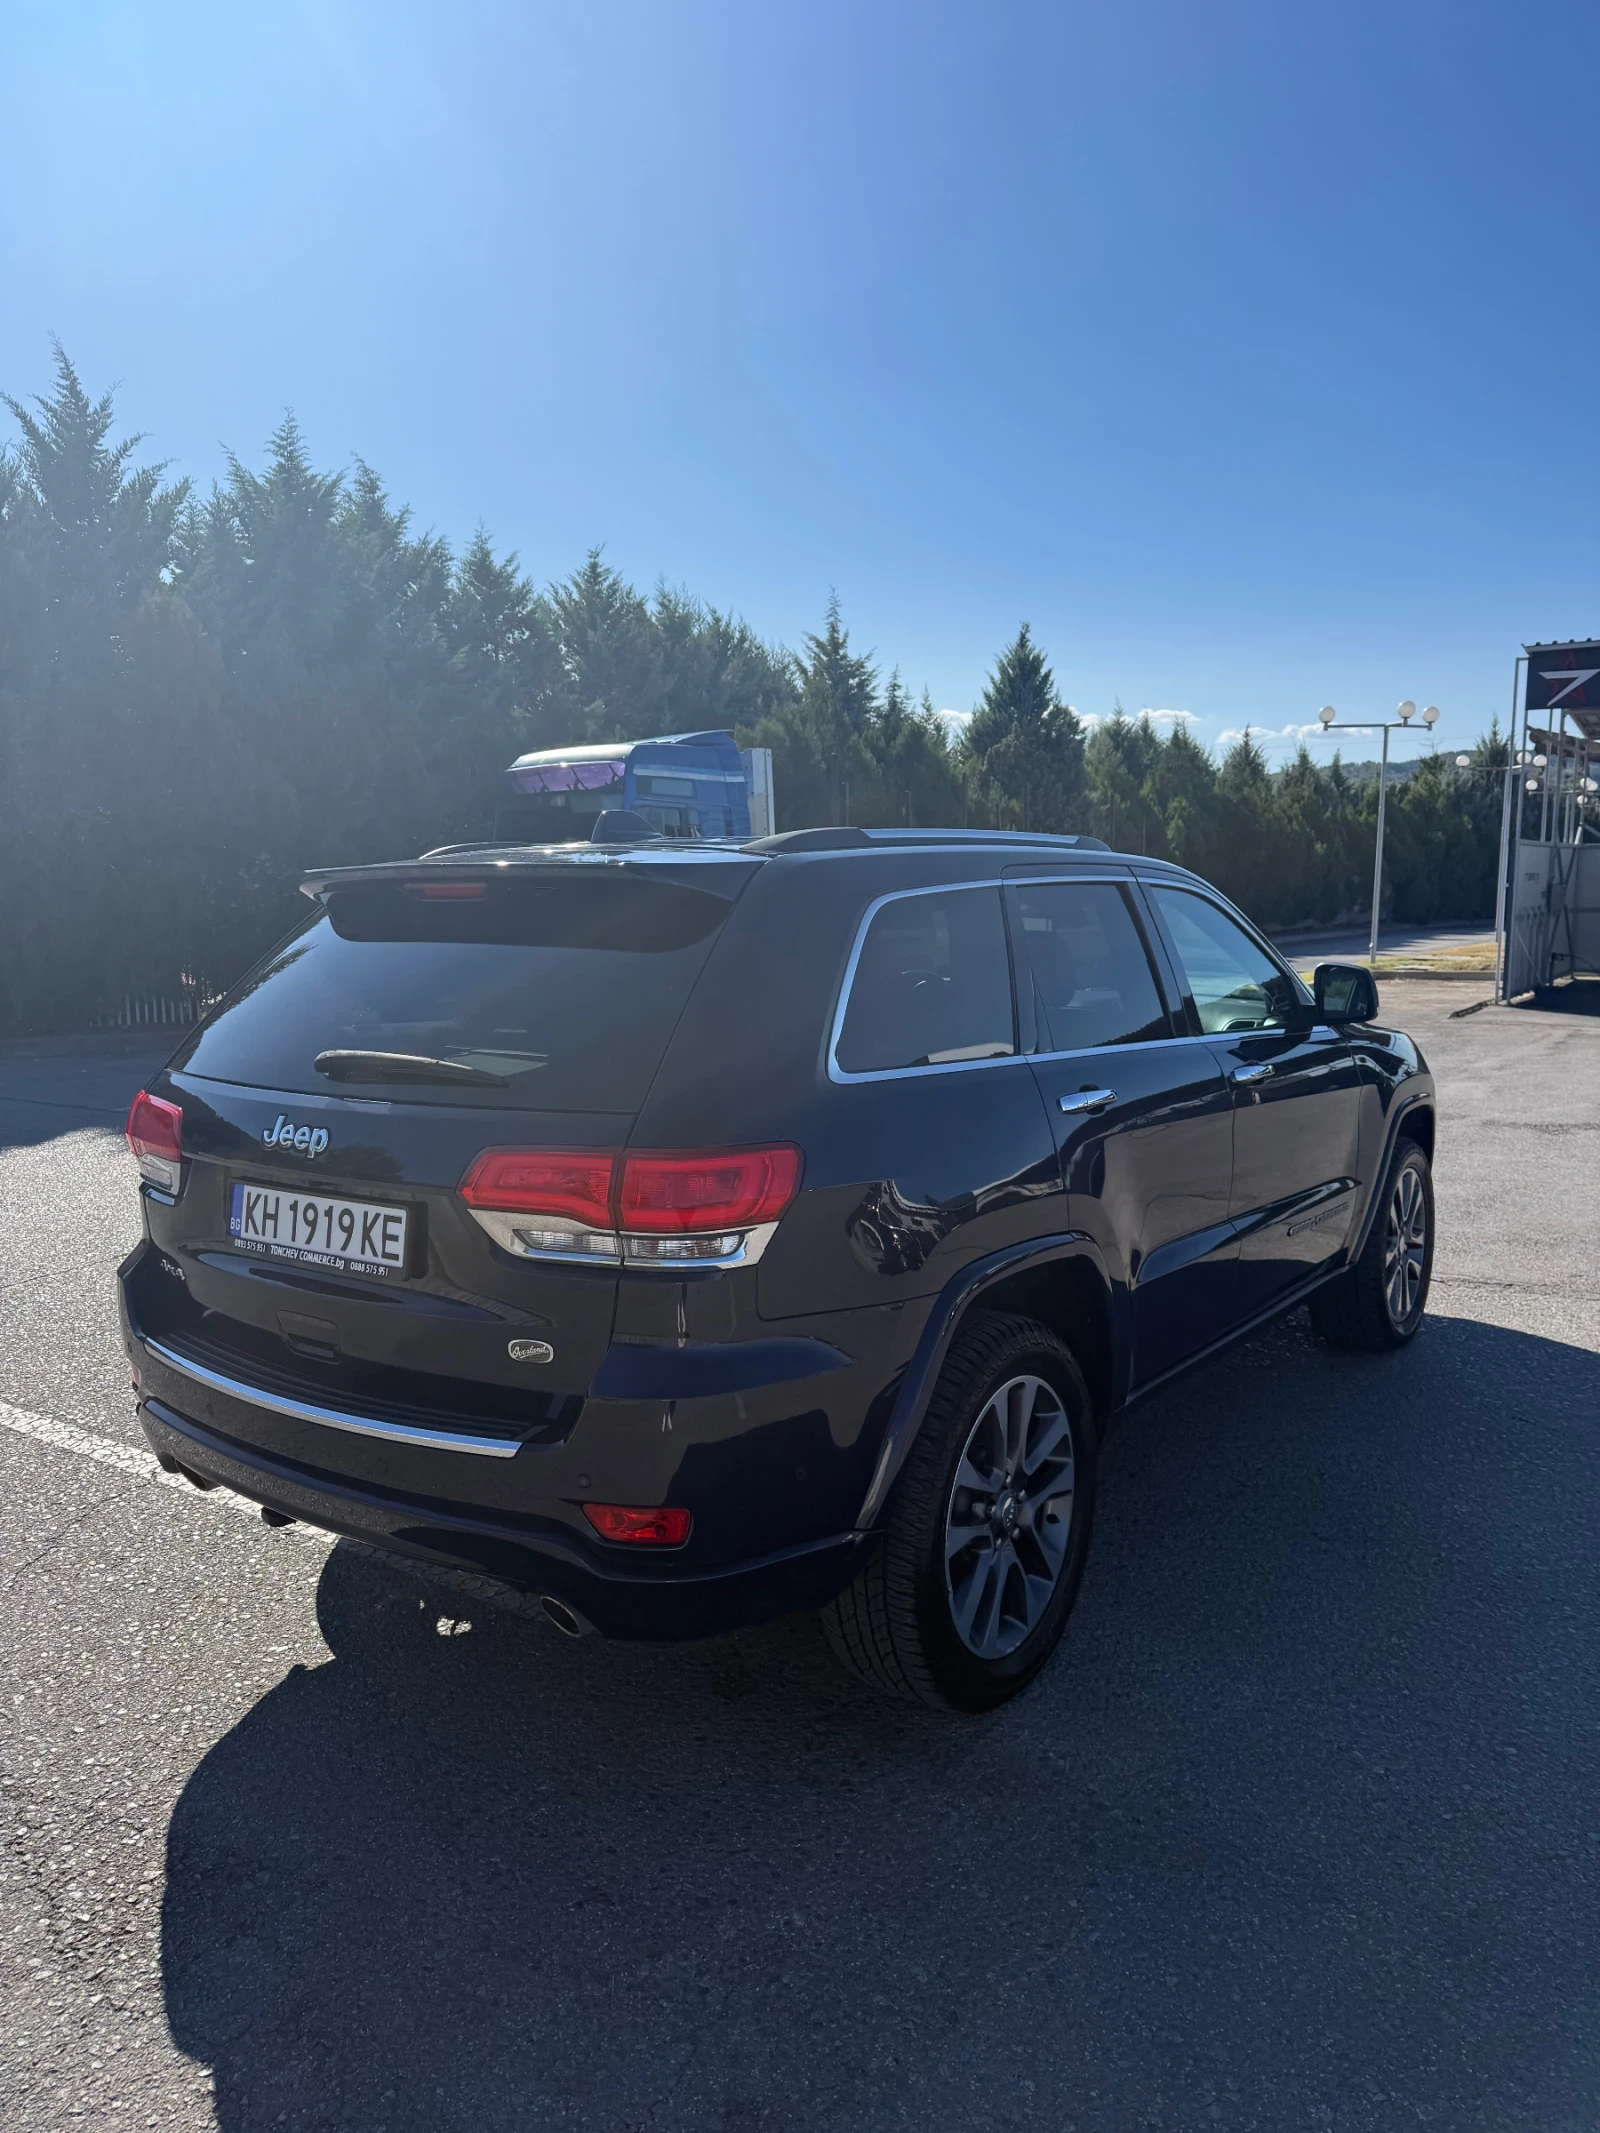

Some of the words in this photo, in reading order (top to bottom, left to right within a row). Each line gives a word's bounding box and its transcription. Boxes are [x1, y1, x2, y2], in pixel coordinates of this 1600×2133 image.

[263, 1115, 329, 1159] Jeep
[230, 1217, 241, 1231] BG
[270, 1244, 299, 1259] TONCHEV
[299, 1250, 345, 1270] COMMERCE.bg
[512, 1345, 549, 1359] Overland
